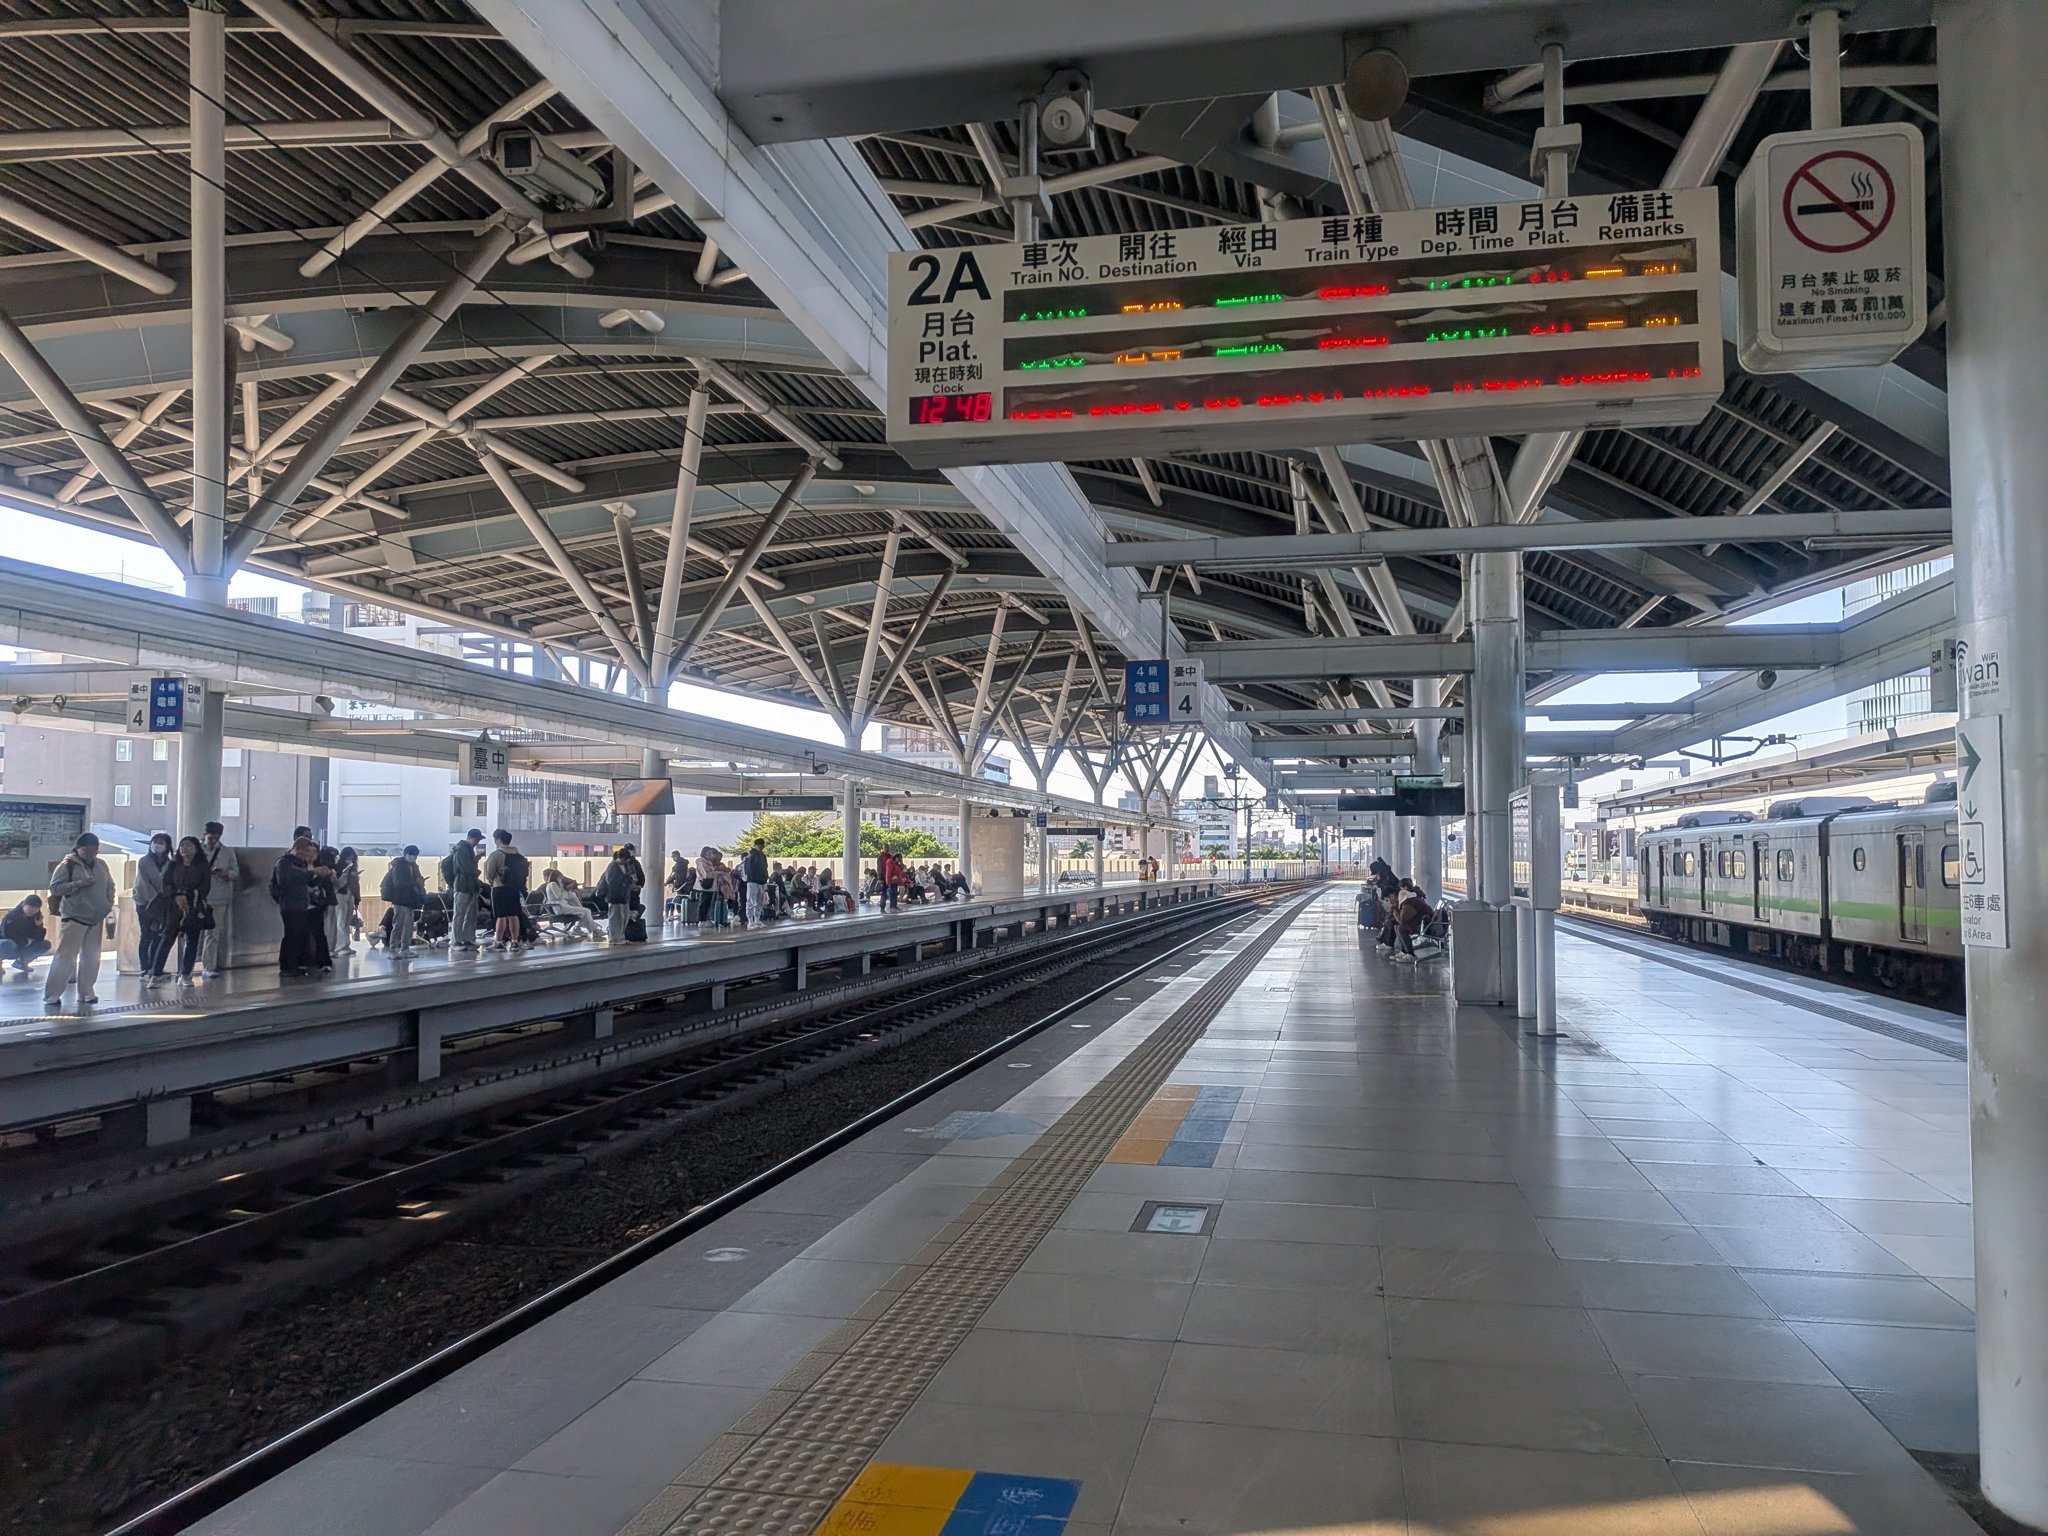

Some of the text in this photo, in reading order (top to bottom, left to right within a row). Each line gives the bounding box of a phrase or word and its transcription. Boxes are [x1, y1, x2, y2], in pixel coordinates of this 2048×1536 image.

[1022, 192, 1674, 269] 車次 開往 經由 車種 時間 月台 備註
[1011, 219, 1685, 286] Train NO. Destination Via Train Type Dep. Time Plat. Remarks
[907, 250, 992, 306] 2A
[1781, 266, 1903, 290] 月台禁止吸菸
[1811, 286, 1871, 297] No Smoking
[922, 309, 975, 338] 月台
[1777, 317, 1825, 326] Maximum
[919, 339, 978, 364] Plat.
[915, 363, 983, 384] 現在時刻
[932, 384, 965, 394] Clock
[919, 396, 947, 424] 12
[956, 393, 992, 422] 48
[1981, 652, 1999, 661] WiFi
[1174, 666, 1196, 677] 臺中
[1135, 682, 1160, 694] 電車
[1135, 704, 1160, 716] 停車
[1178, 694, 1193, 714] 4
[133, 709, 144, 726] 4
[474, 747, 505, 771] 臺中
[1973, 929, 1992, 941] Area
